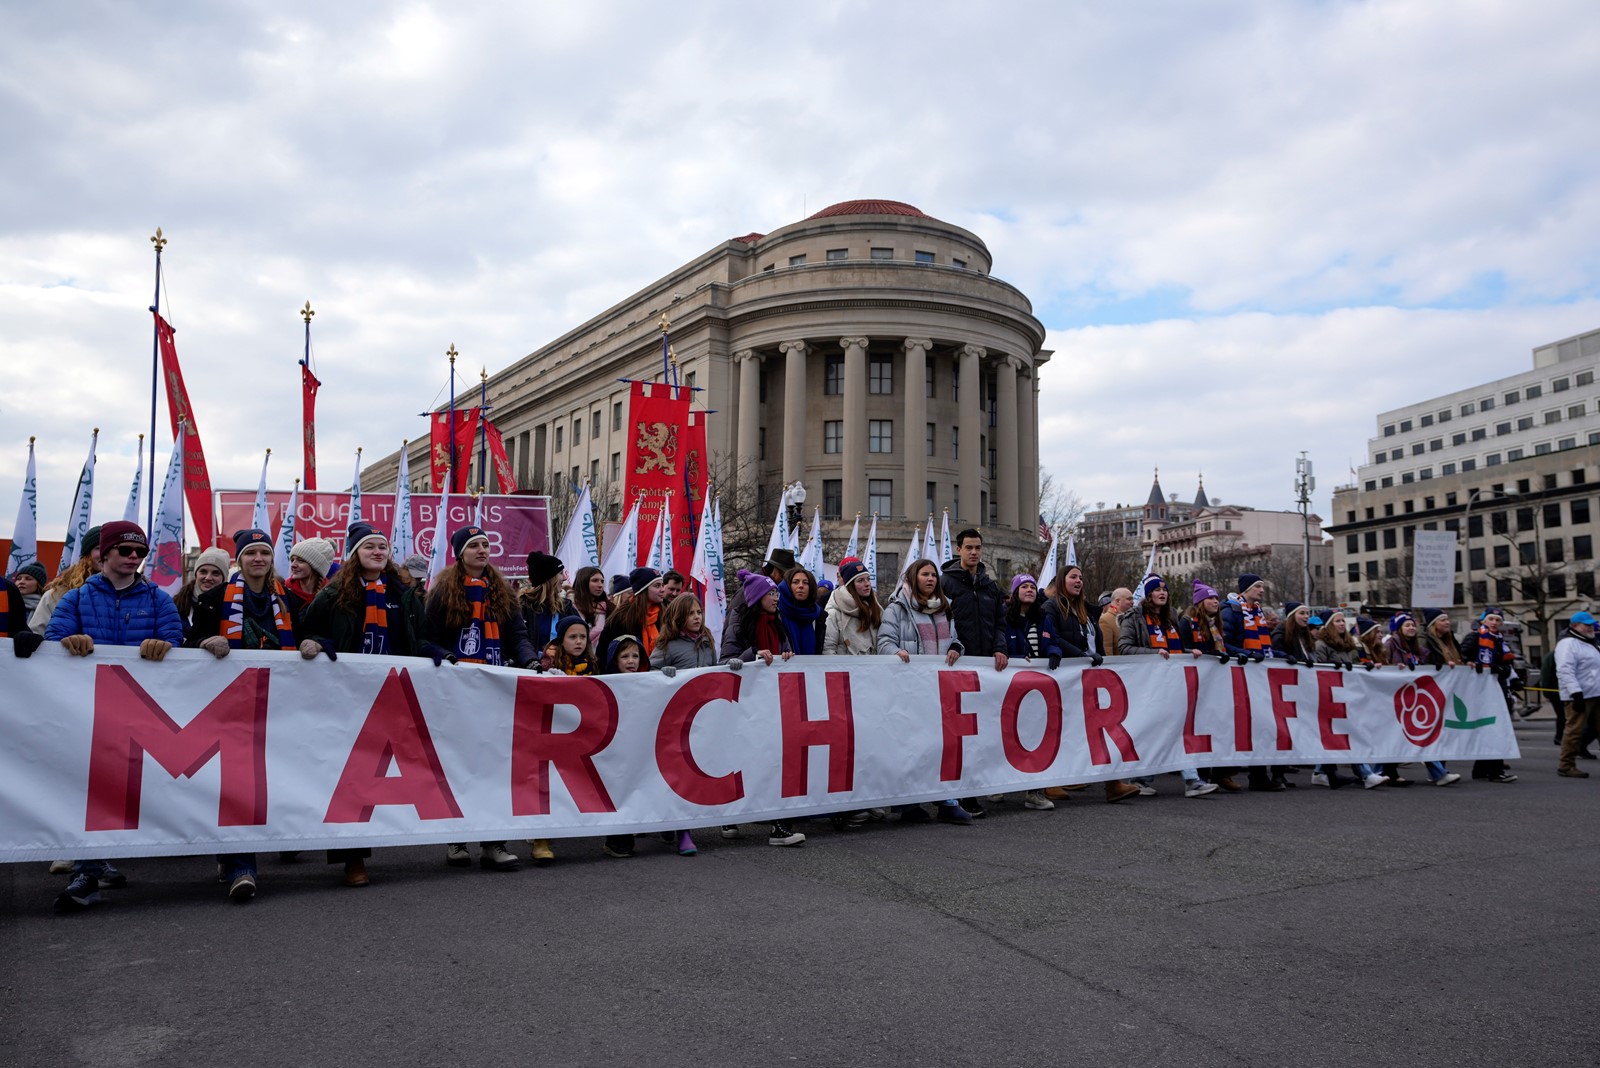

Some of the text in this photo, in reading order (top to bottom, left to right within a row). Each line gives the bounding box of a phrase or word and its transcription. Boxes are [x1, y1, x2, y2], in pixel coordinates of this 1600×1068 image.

[631, 485, 676, 497] Traditin
[641, 500, 666, 510] amil
[280, 502, 393, 528] EQUAIT
[638, 513, 675, 523] ropey
[582, 512, 599, 569] Marc
[85, 664, 1351, 832] MARCH FOR LIFE
